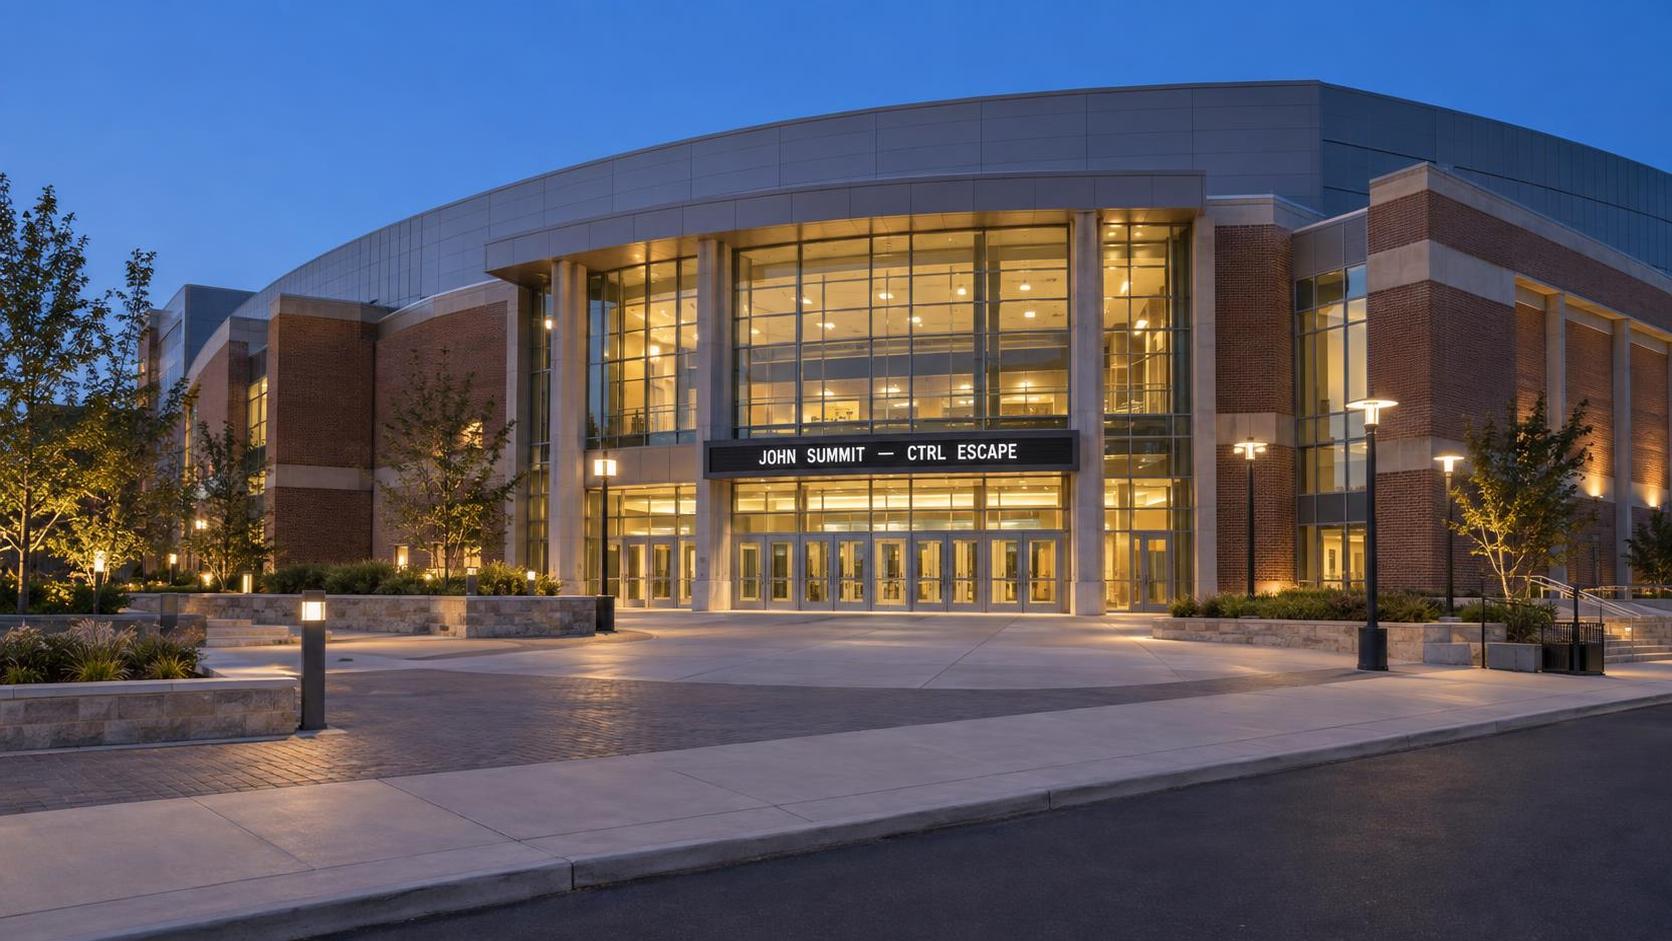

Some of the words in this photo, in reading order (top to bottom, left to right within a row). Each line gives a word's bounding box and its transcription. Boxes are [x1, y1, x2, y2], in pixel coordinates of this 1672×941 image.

[758, 449, 796, 465] JOHN
[807, 447, 865, 463] SUMMIT
[907, 445, 946, 460] CTRL
[957, 443, 1018, 459] ESCAPE
